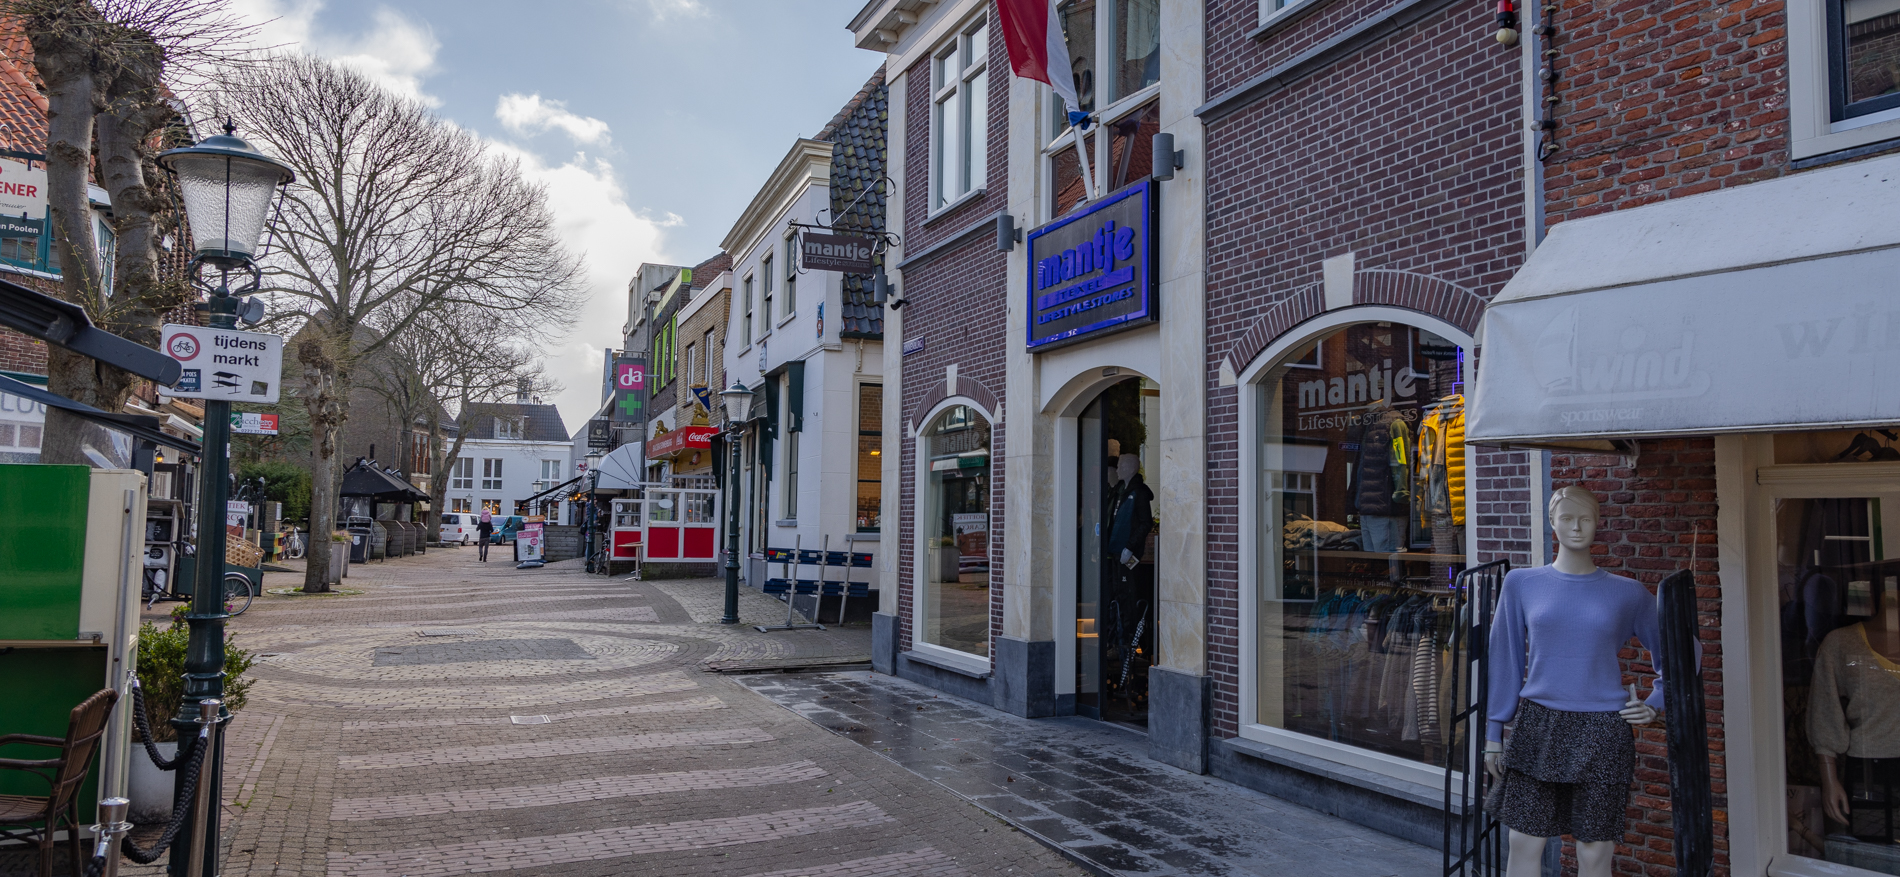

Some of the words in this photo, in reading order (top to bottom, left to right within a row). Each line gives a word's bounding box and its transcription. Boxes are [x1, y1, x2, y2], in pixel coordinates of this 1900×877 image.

[8, 223, 39, 234] Poolen
[805, 241, 870, 262] mantje
[805, 256, 842, 267] Lifestyle
[1037, 220, 1134, 291] mantje
[1060, 280, 1103, 300] TEXEL
[214, 335, 267, 351] tijdens
[213, 355, 260, 367] markt
[620, 367, 643, 386] da
[1300, 359, 1416, 409] mantje
[1299, 411, 1362, 431] Lifestyle
[1560, 407, 1644, 427] sportswear
[942, 431, 980, 453] mantje
